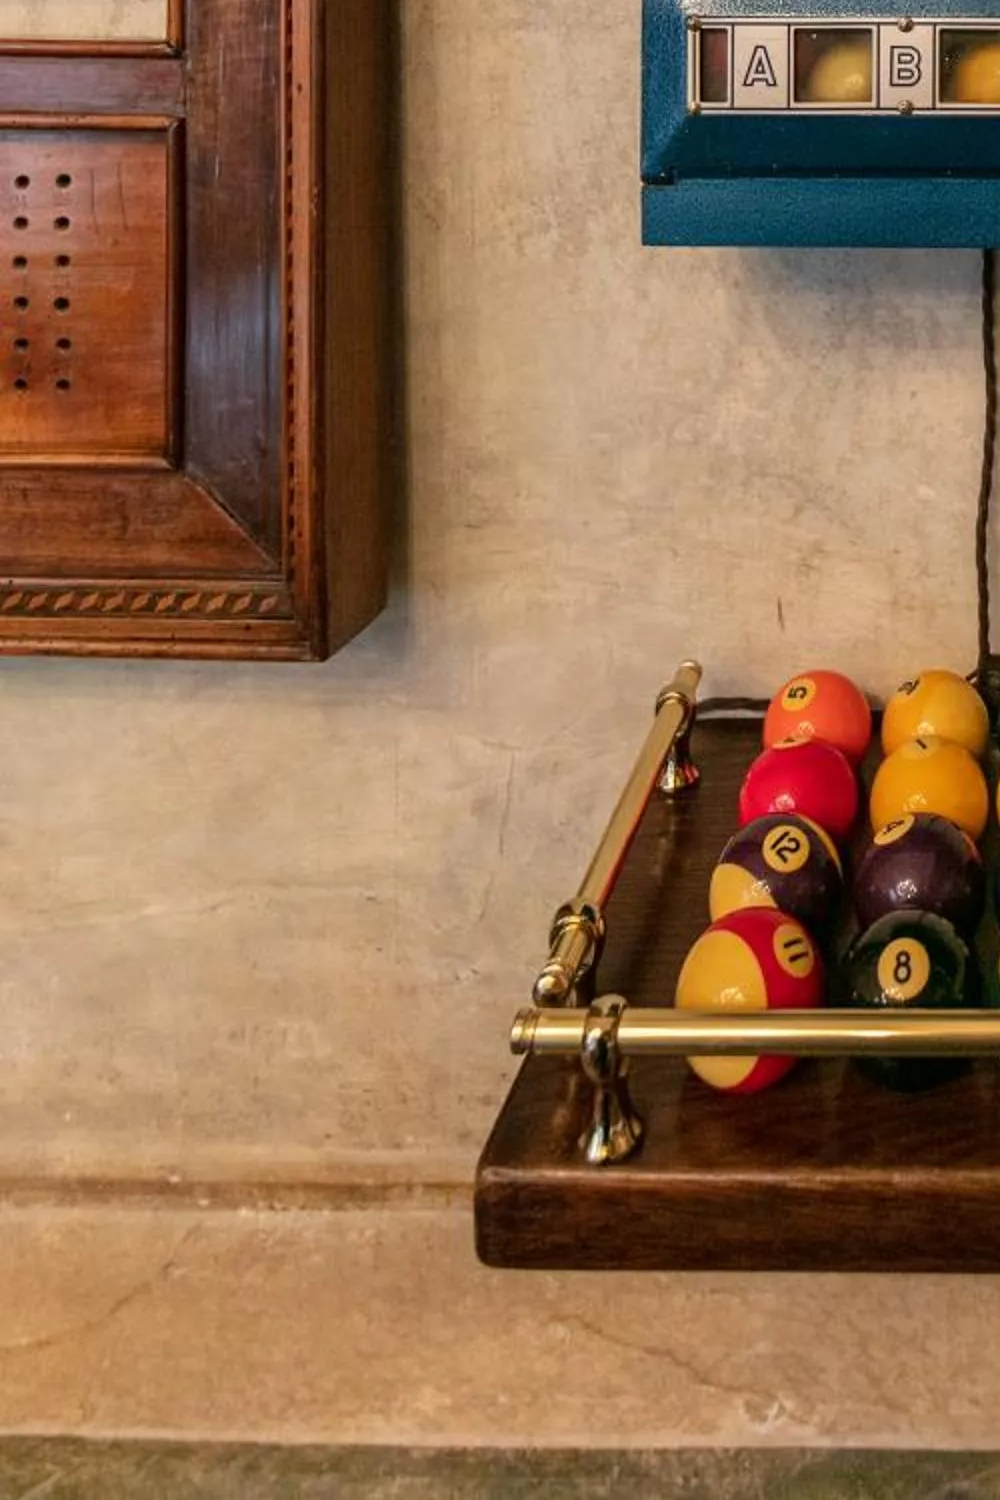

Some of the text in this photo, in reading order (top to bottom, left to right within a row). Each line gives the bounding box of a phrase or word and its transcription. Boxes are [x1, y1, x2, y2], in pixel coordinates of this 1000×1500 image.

[742, 45, 778, 88] A
[889, 45, 922, 87] B
[770, 830, 801, 864] 12
[783, 937, 809, 963] 11
[894, 950, 912, 984] 8
